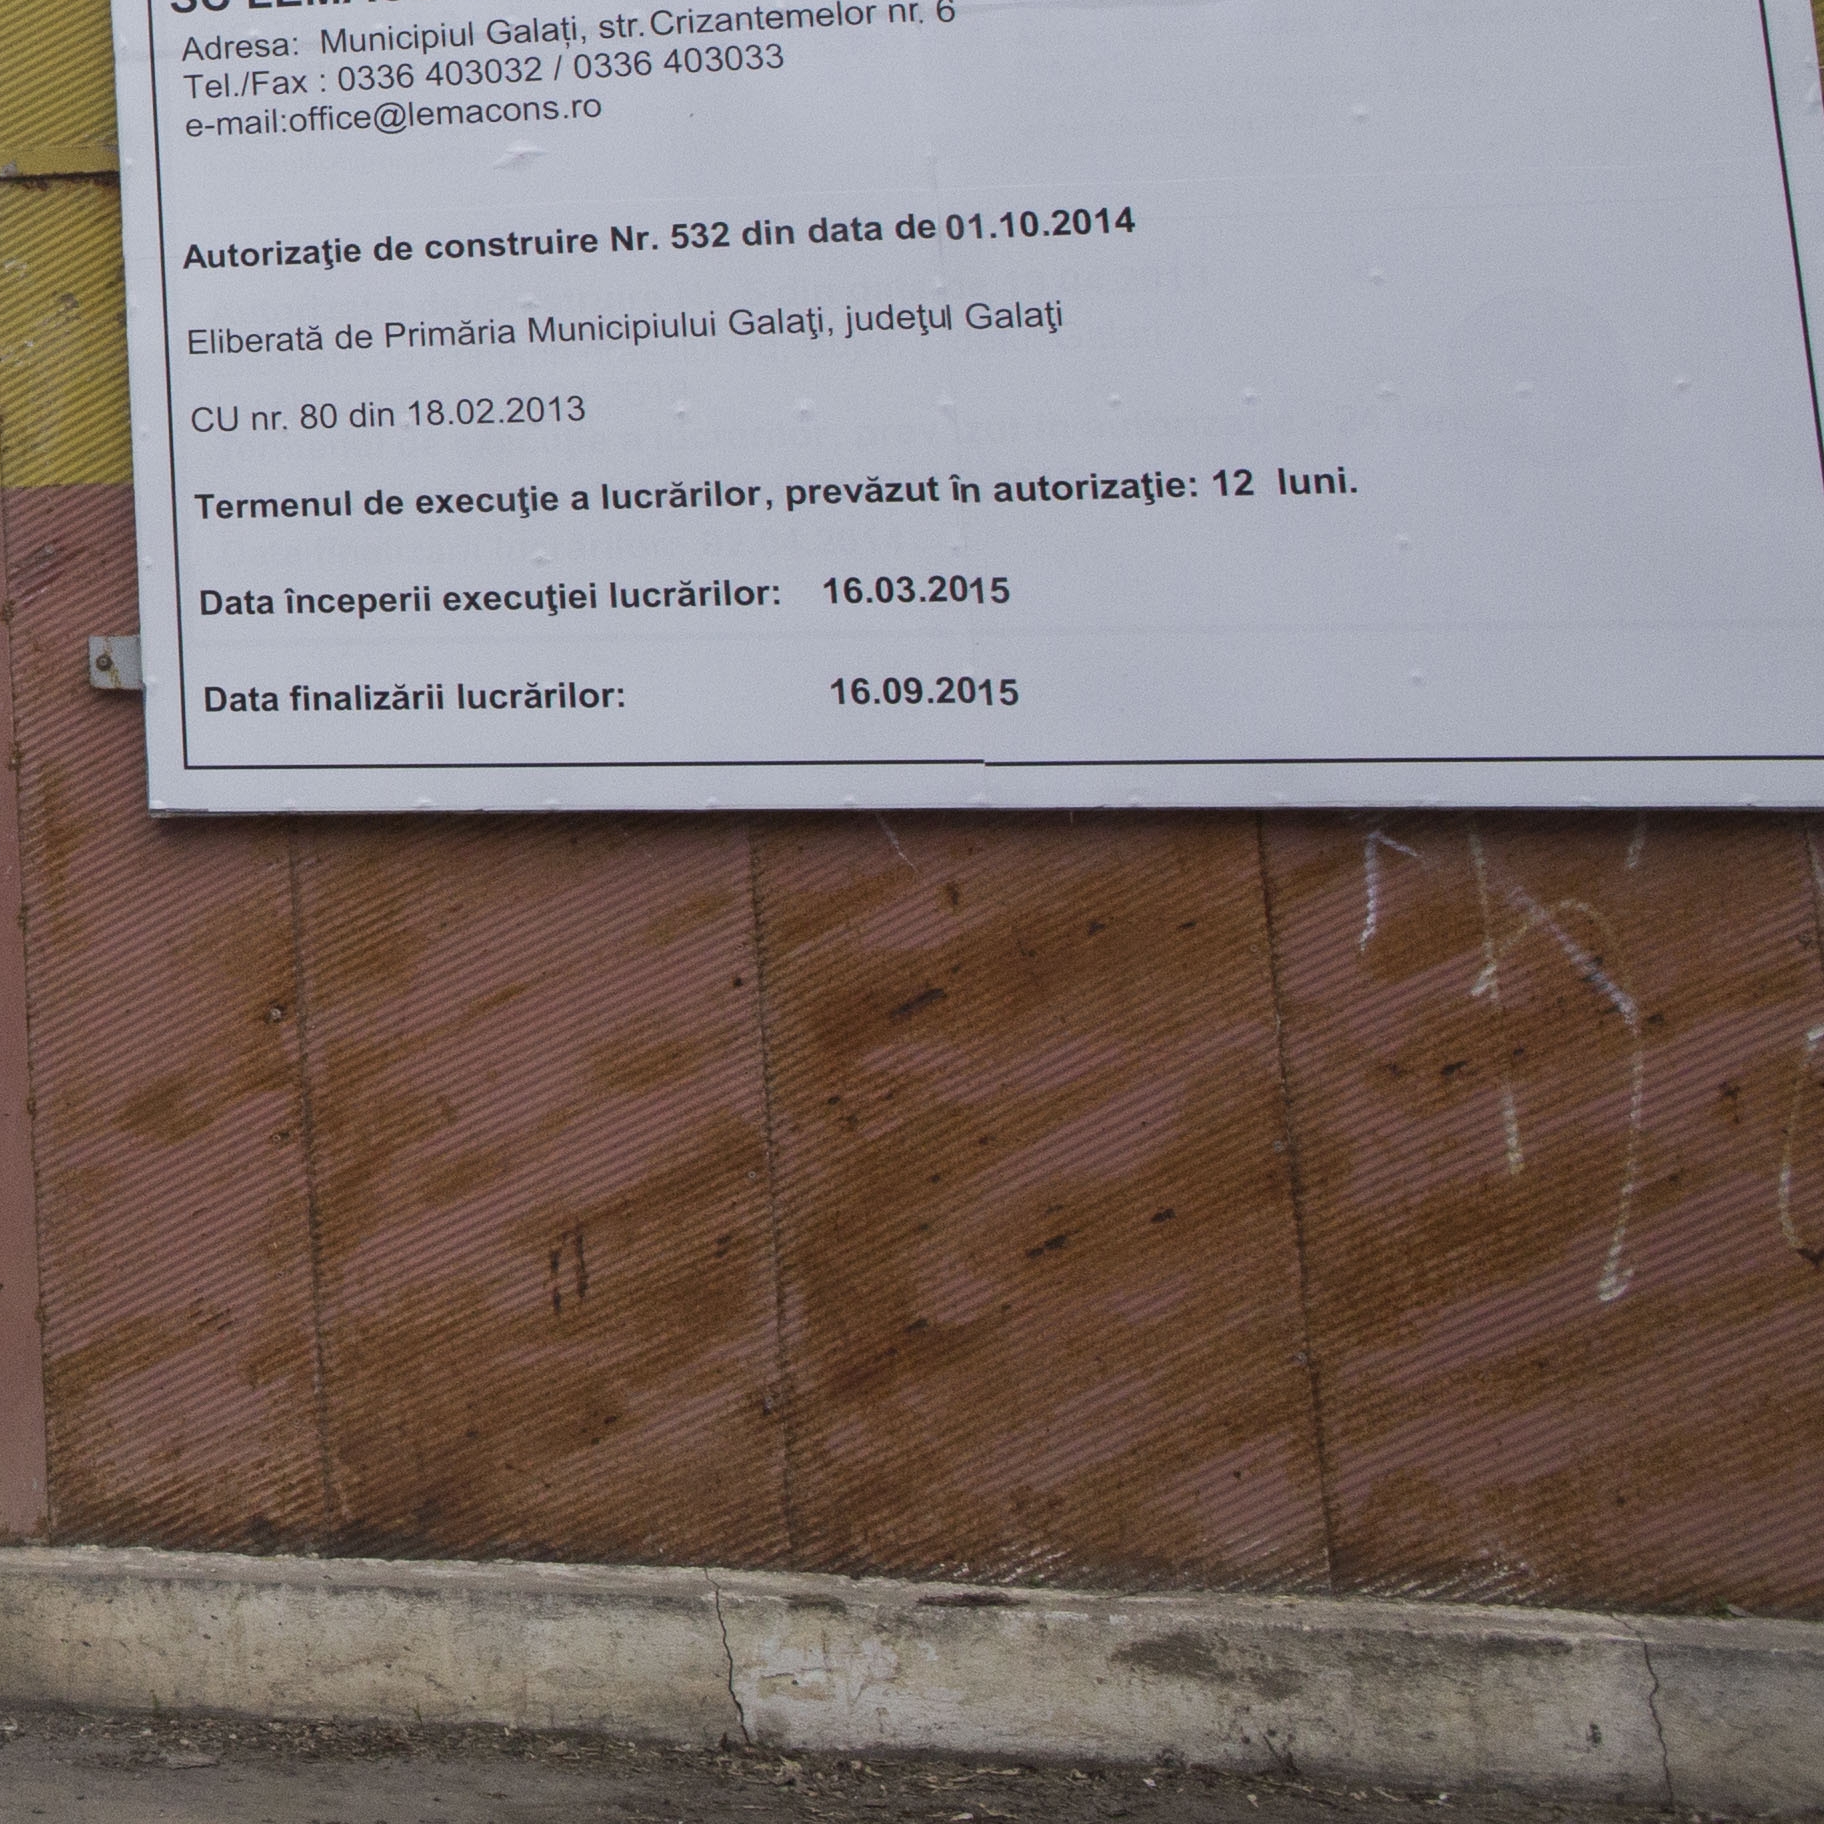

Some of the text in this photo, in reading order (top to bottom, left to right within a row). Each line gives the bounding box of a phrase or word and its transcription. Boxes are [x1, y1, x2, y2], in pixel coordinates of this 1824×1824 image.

[181, 34, 299, 62] Adresa:
[320, 20, 475, 56] Municipiul
[598, 13, 645, 40] str.
[649, 0, 878, 37] Crizantemelor
[887, 1, 924, 25] nr.
[182, 42, 785, 100] Tel./Fax 0336 403032 0336 403033
[185, 98, 603, 138] e-mail:office@lemacons.ro
[372, 234, 414, 262] de
[424, 227, 599, 260] construire
[609, 225, 659, 253] Nr.
[670, 220, 731, 250] 532
[741, 219, 796, 247] din
[807, 216, 884, 244] data
[894, 212, 937, 241] de
[945, 205, 1137, 241] 01.10.2014
[187, 324, 324, 356] Eliberată
[334, 323, 374, 350] de
[384, 318, 517, 349] Primăria
[527, 309, 717, 347] Municipiului
[190, 394, 586, 433] CU nr. 80 din 18.02.2013
[193, 489, 352, 520] Termenul
[363, 488, 405, 516] de
[570, 490, 591, 511] a
[601, 479, 774, 512] lucrărilor,
[785, 475, 941, 513] prevăzut
[948, 473, 982, 504] în
[1212, 467, 1255, 497] 12
[1277, 465, 1358, 496] luni.
[199, 588, 275, 616] Data
[283, 584, 431, 621] începerii
[609, 579, 781, 609] lucrărilor:
[822, 573, 1011, 605] 16.03.2015
[203, 675, 1020, 713] Data finalizării lucrărilor: 16.09.2015
